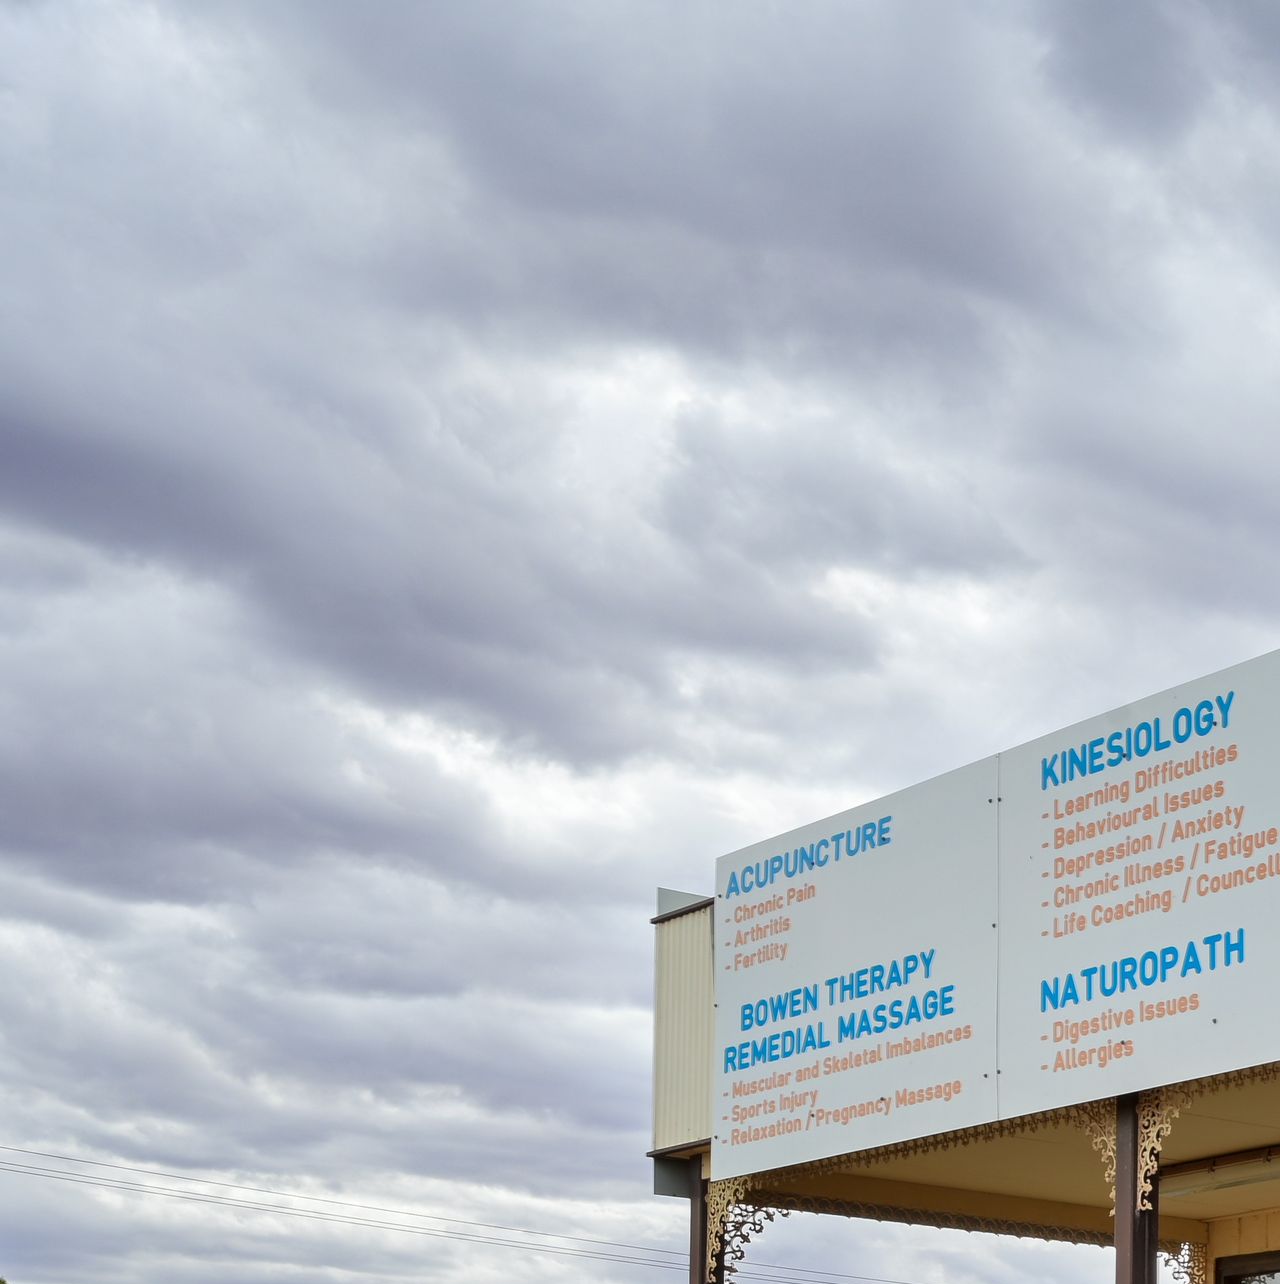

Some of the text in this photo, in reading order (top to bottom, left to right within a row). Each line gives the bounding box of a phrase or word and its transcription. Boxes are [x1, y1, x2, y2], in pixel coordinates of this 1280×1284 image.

[1040, 691, 1235, 791] KINESIOLOGY
[1053, 780, 1130, 821] Learning
[1134, 742, 1238, 793] Difficulties
[1053, 796, 1159, 850] Behavioural
[1163, 780, 1224, 814] Issues
[725, 815, 892, 899] ACUPUNCTURE
[1053, 834, 1152, 880] Depression
[1171, 806, 1245, 841] Anxiety
[1054, 874, 1119, 909] Chronic
[1123, 854, 1185, 887] Illness
[1202, 827, 1278, 864] Fatigue
[734, 895, 783, 924] Chronic
[785, 884, 816, 906] Pain
[734, 917, 791, 947] Arthritis
[1053, 912, 1086, 939] Life
[1089, 889, 1172, 928] Coaching
[734, 944, 788, 971] Fertility
[740, 949, 935, 1032] BOWEN THERAPY
[1039, 928, 1245, 1013] NATUROPATH
[723, 985, 955, 1073] REMEDIAL MASSAGE
[1051, 1008, 1135, 1044] Digestive
[1137, 992, 1200, 1023] Issues
[730, 1072, 791, 1097] Muscular
[795, 1061, 819, 1083] and
[822, 1046, 882, 1076] Skeletal
[886, 1024, 973, 1060] Imbalances
[1051, 1039, 1134, 1072] Allergies
[729, 1118, 802, 1145] Relaxation
[814, 1097, 892, 1126] Pregnancy
[895, 1079, 962, 1109] Massage
[731, 1100, 776, 1123] Sports
[779, 1090, 818, 1111] Injury
